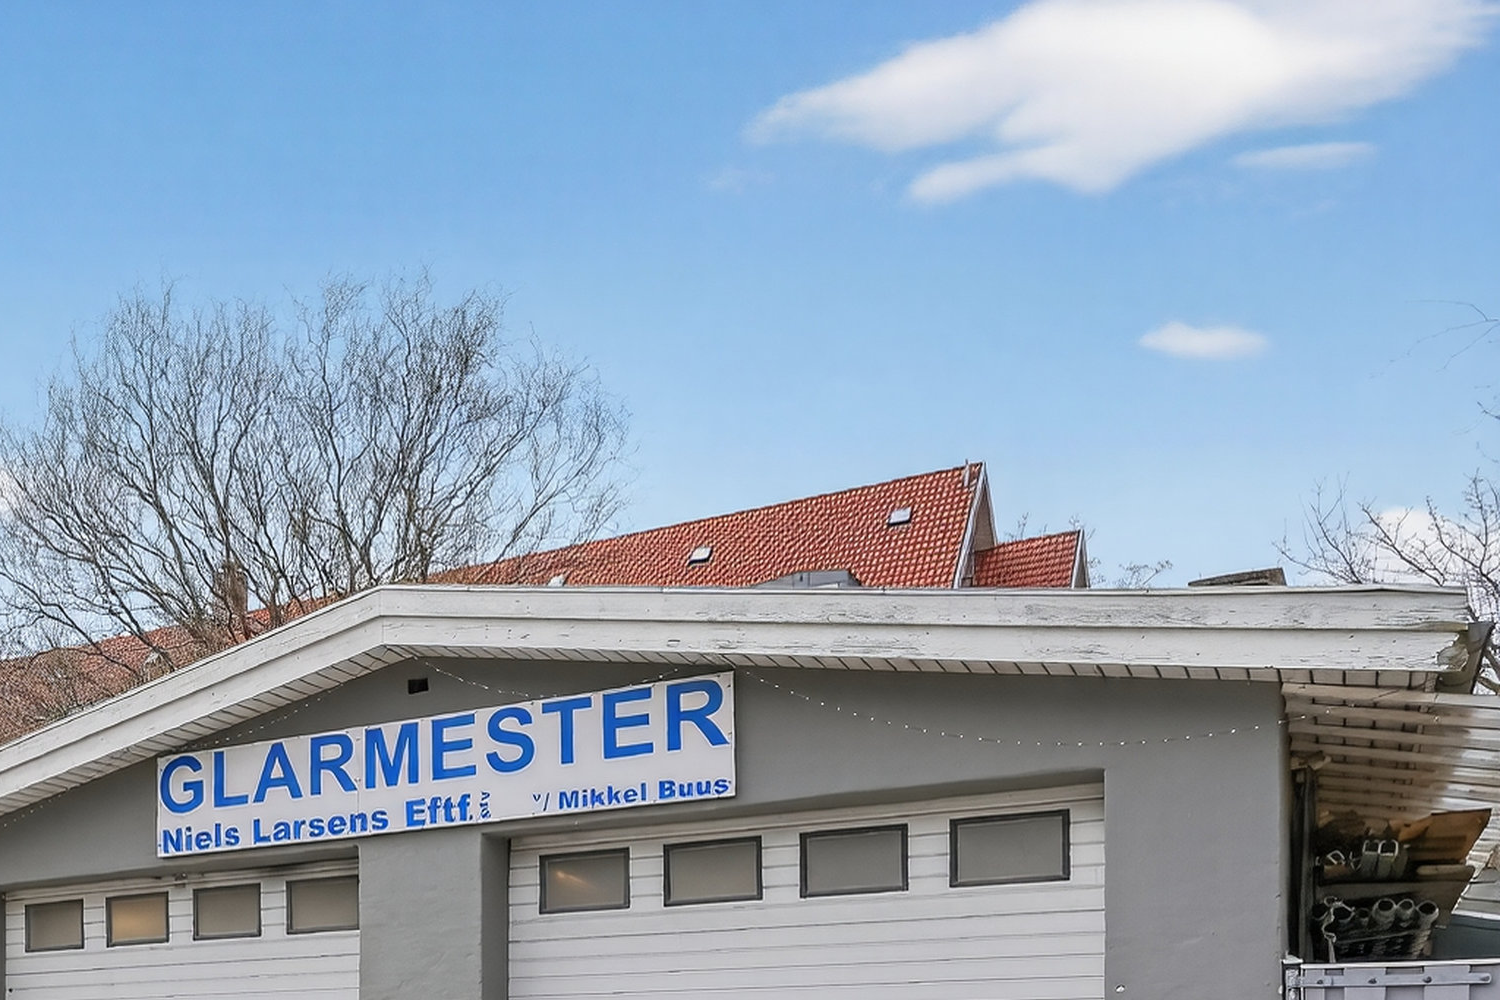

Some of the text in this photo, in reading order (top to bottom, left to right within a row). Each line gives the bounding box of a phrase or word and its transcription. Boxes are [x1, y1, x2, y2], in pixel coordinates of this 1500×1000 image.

[160, 679, 730, 814] GLARMESTER
[162, 822, 241, 854] Niels
[253, 809, 389, 845] Larsens
[406, 792, 473, 828] Eftf.
[558, 782, 647, 810] Mikkel
[659, 778, 729, 800] Buus
